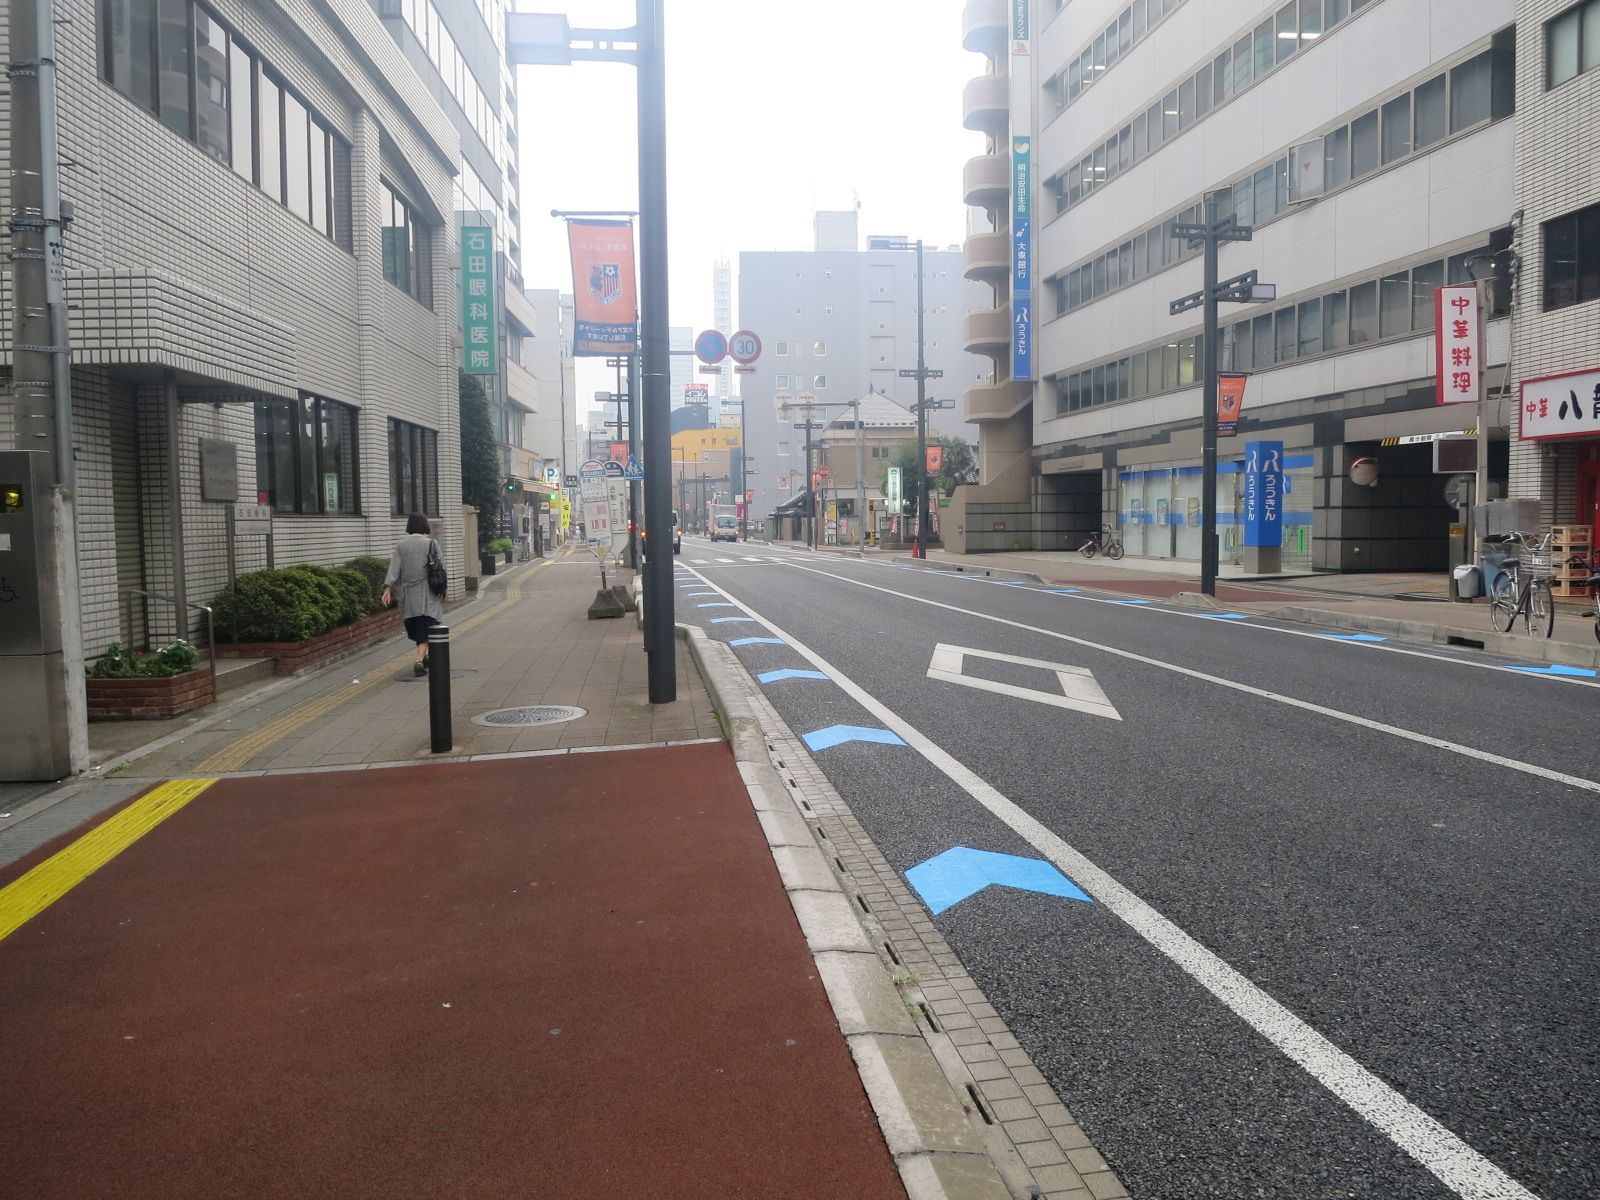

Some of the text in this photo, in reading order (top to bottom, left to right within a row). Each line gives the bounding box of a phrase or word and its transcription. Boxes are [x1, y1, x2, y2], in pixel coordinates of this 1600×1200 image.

[1017, 163, 1026, 212] 明治安田生命
[1017, 242, 1027, 279] 大東銀行
[467, 232, 490, 368] 石田眼科医院
[736, 339, 755, 355] 30
[1018, 324, 1027, 355] ろうきん
[1451, 296, 1472, 393] 中華料理
[1526, 398, 1548, 421] 中華
[547, 468, 556, 482] P
[1248, 475, 1256, 521] ろうきん
[1265, 474, 1276, 521] ろうきん
